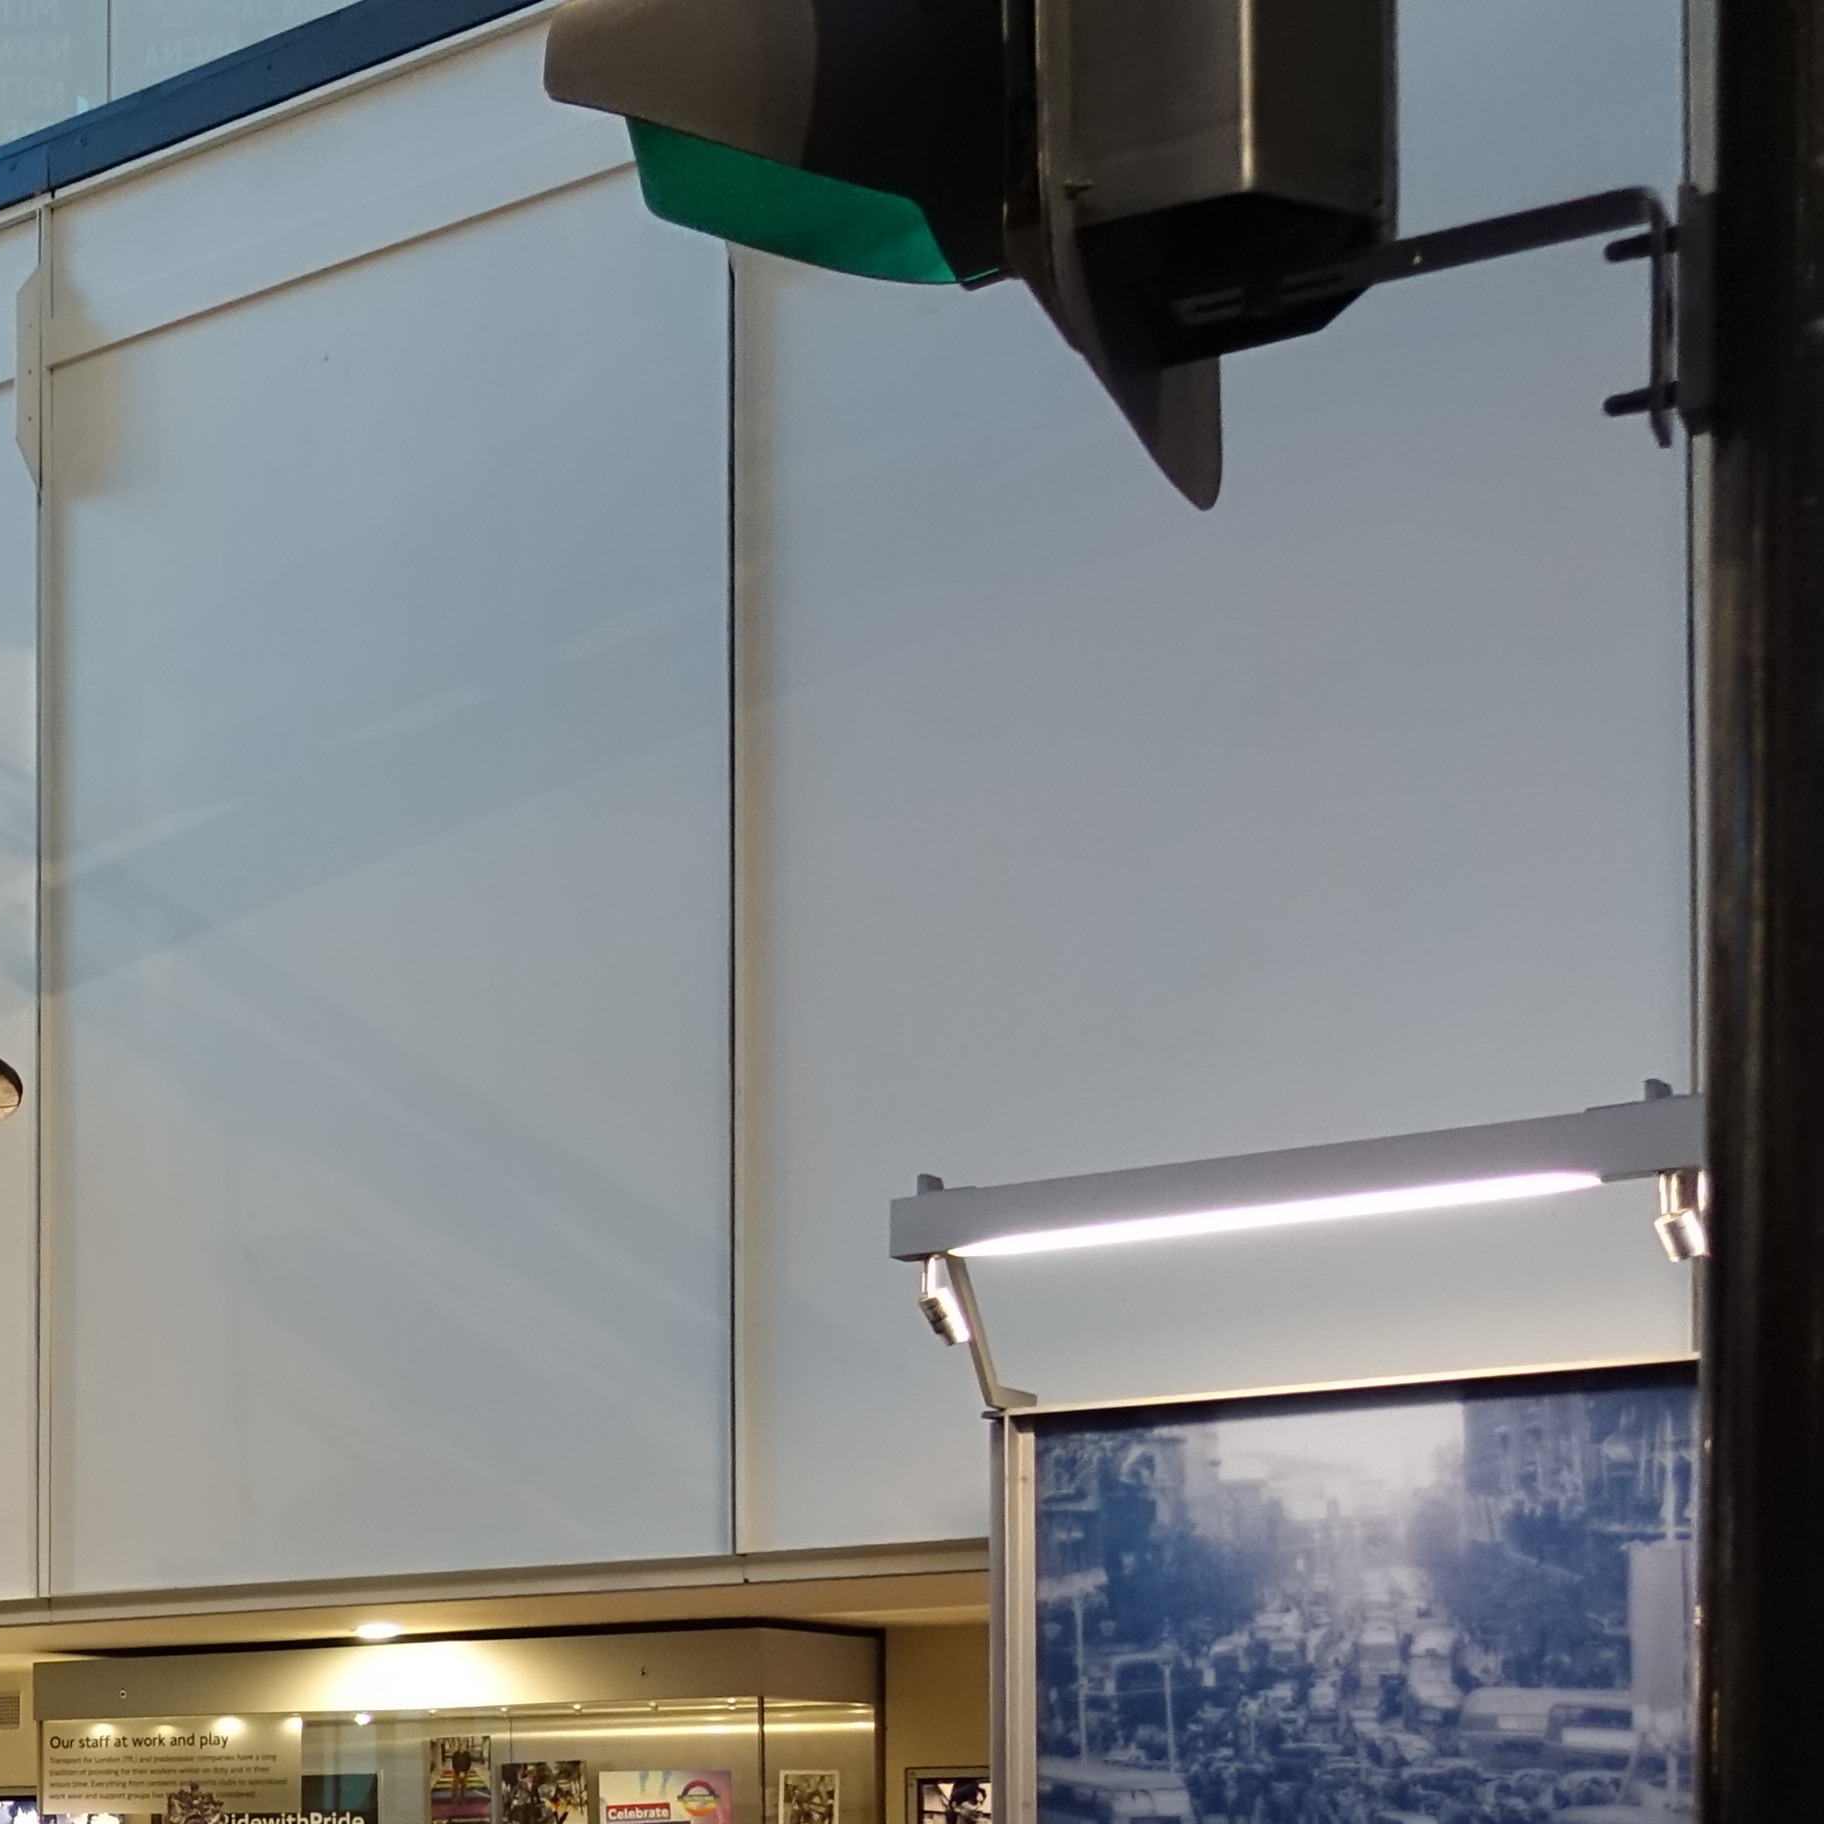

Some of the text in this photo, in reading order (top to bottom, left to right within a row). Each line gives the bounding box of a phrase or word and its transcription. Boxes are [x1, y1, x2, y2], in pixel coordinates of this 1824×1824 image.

[49, 1733, 229, 1750] Our staff at work and play
[608, 1806, 670, 1820] Celebrate
